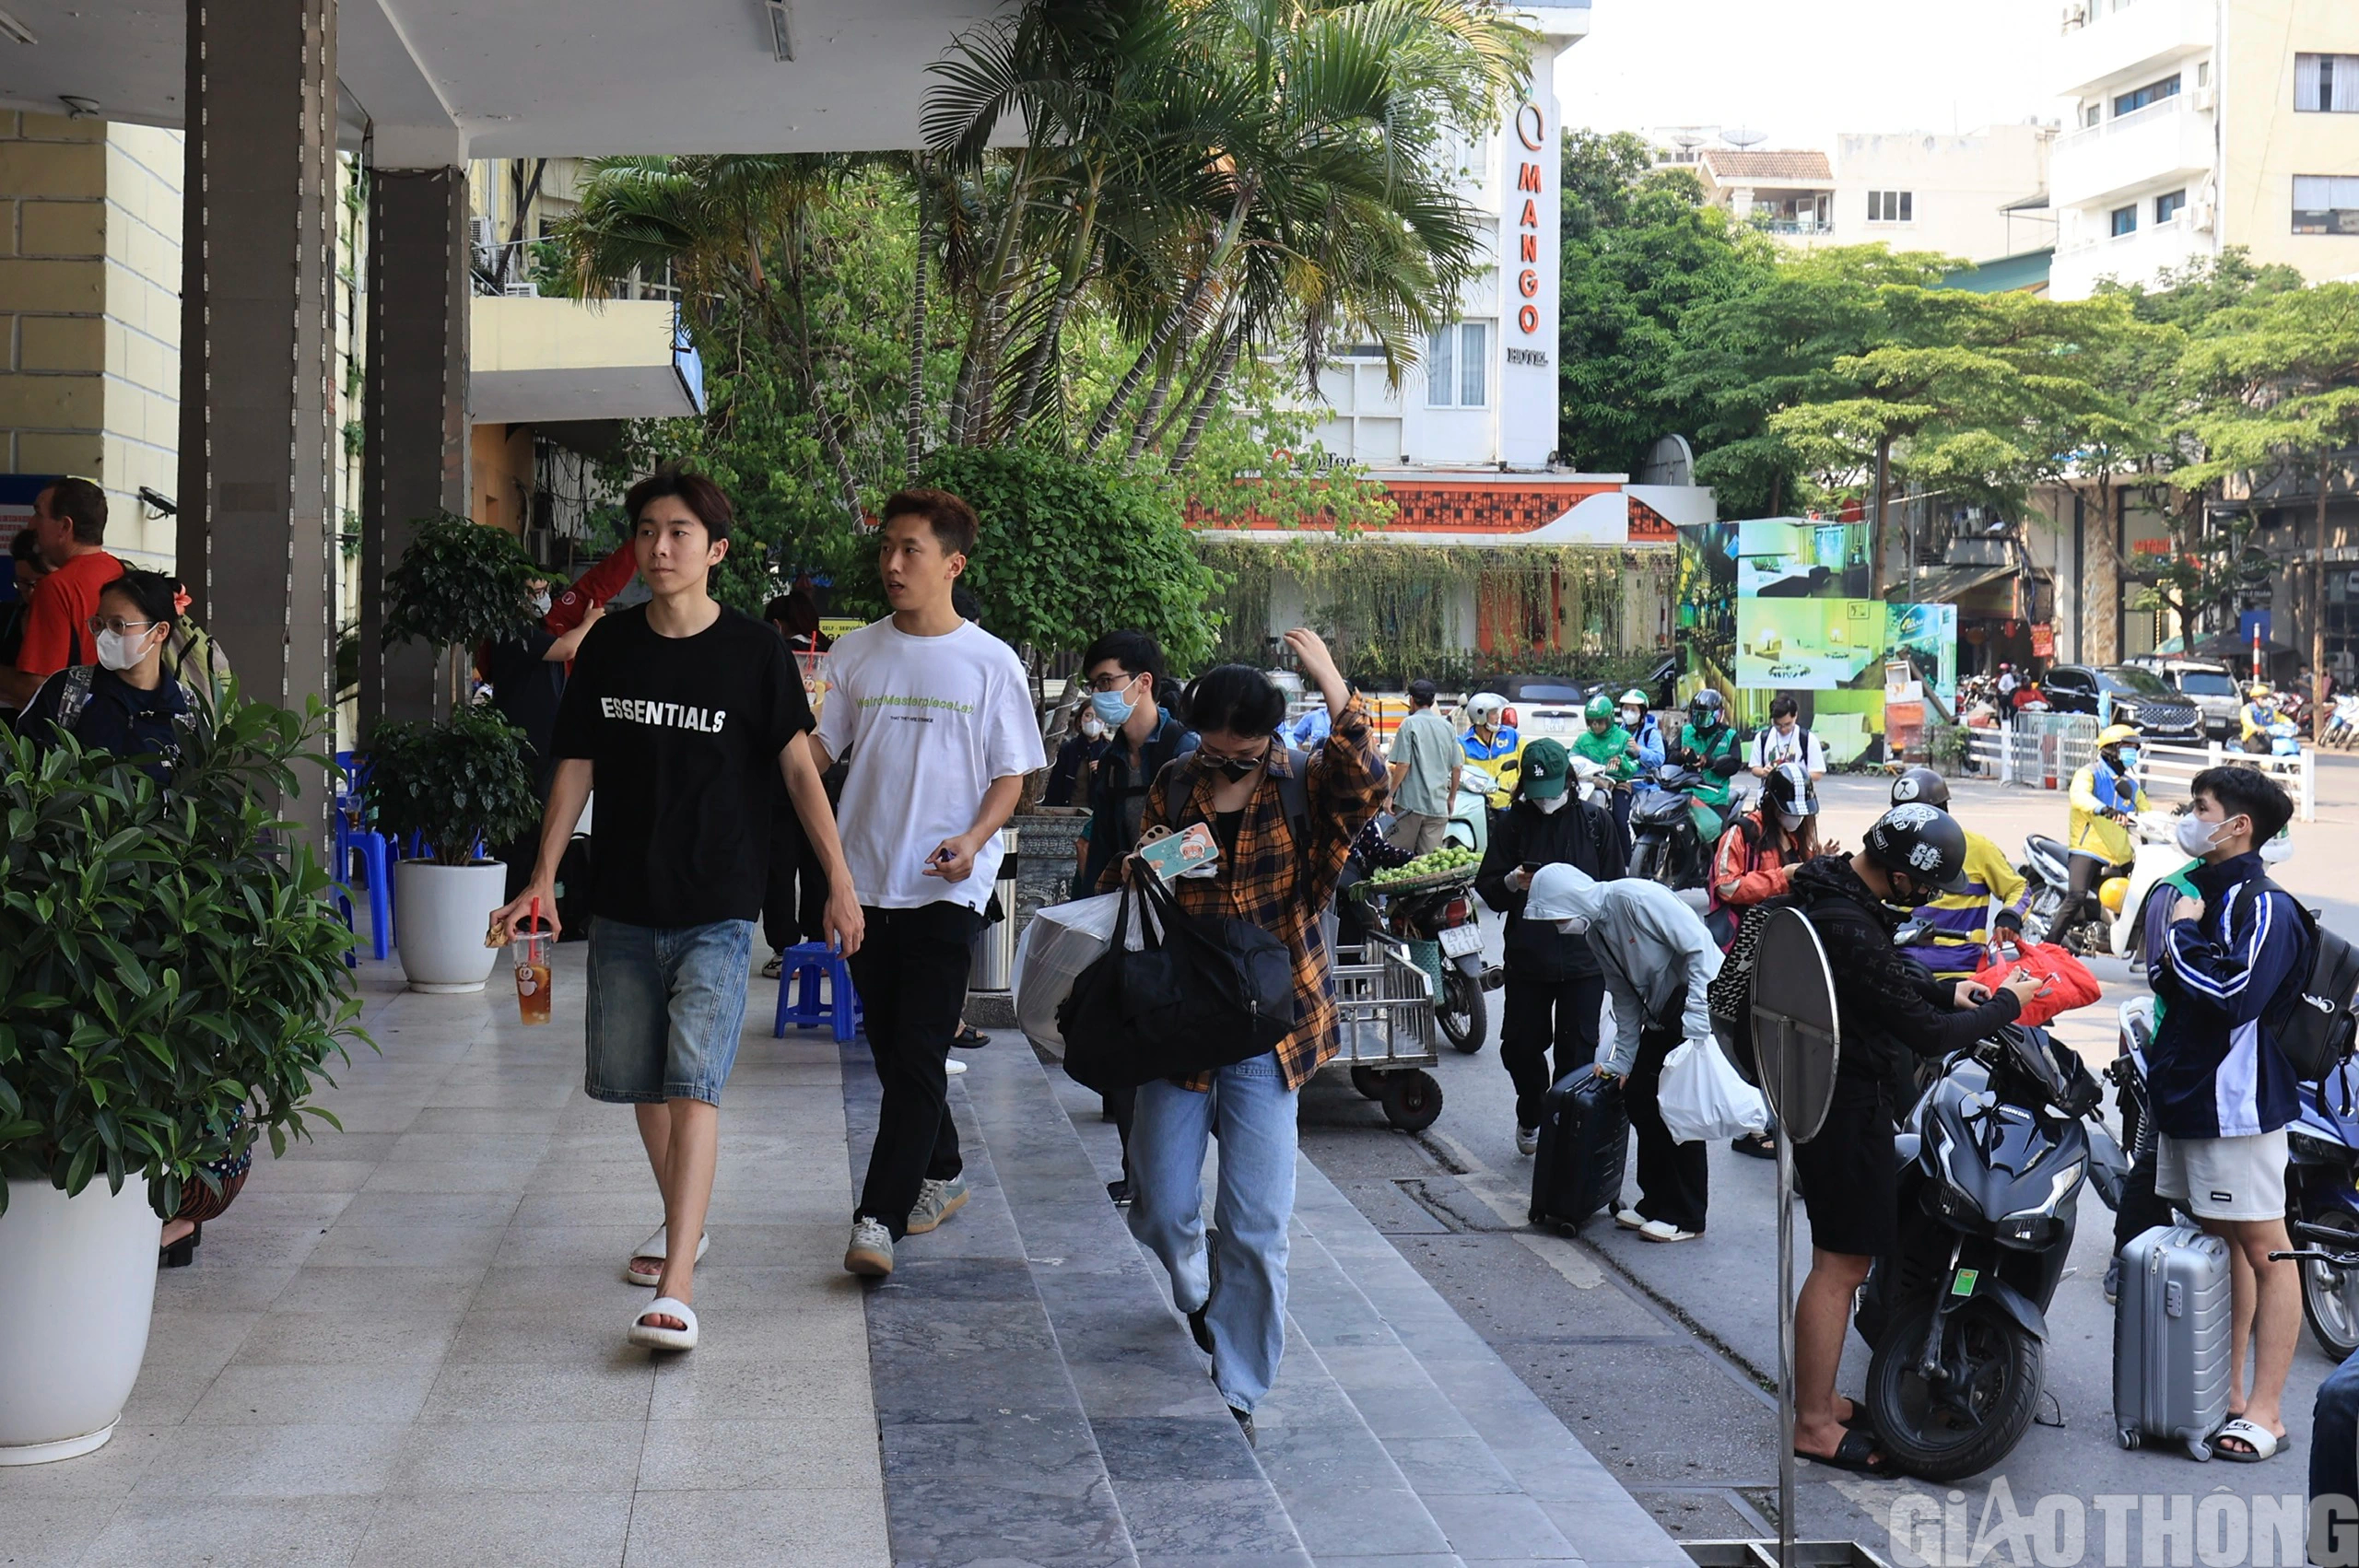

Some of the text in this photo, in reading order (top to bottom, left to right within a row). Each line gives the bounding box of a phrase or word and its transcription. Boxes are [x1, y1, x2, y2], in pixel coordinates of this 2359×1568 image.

[1518, 162, 1542, 334] MANGO
[601, 697, 726, 732] ESSENTIALS
[1999, 1106, 2031, 1119] HONDA
